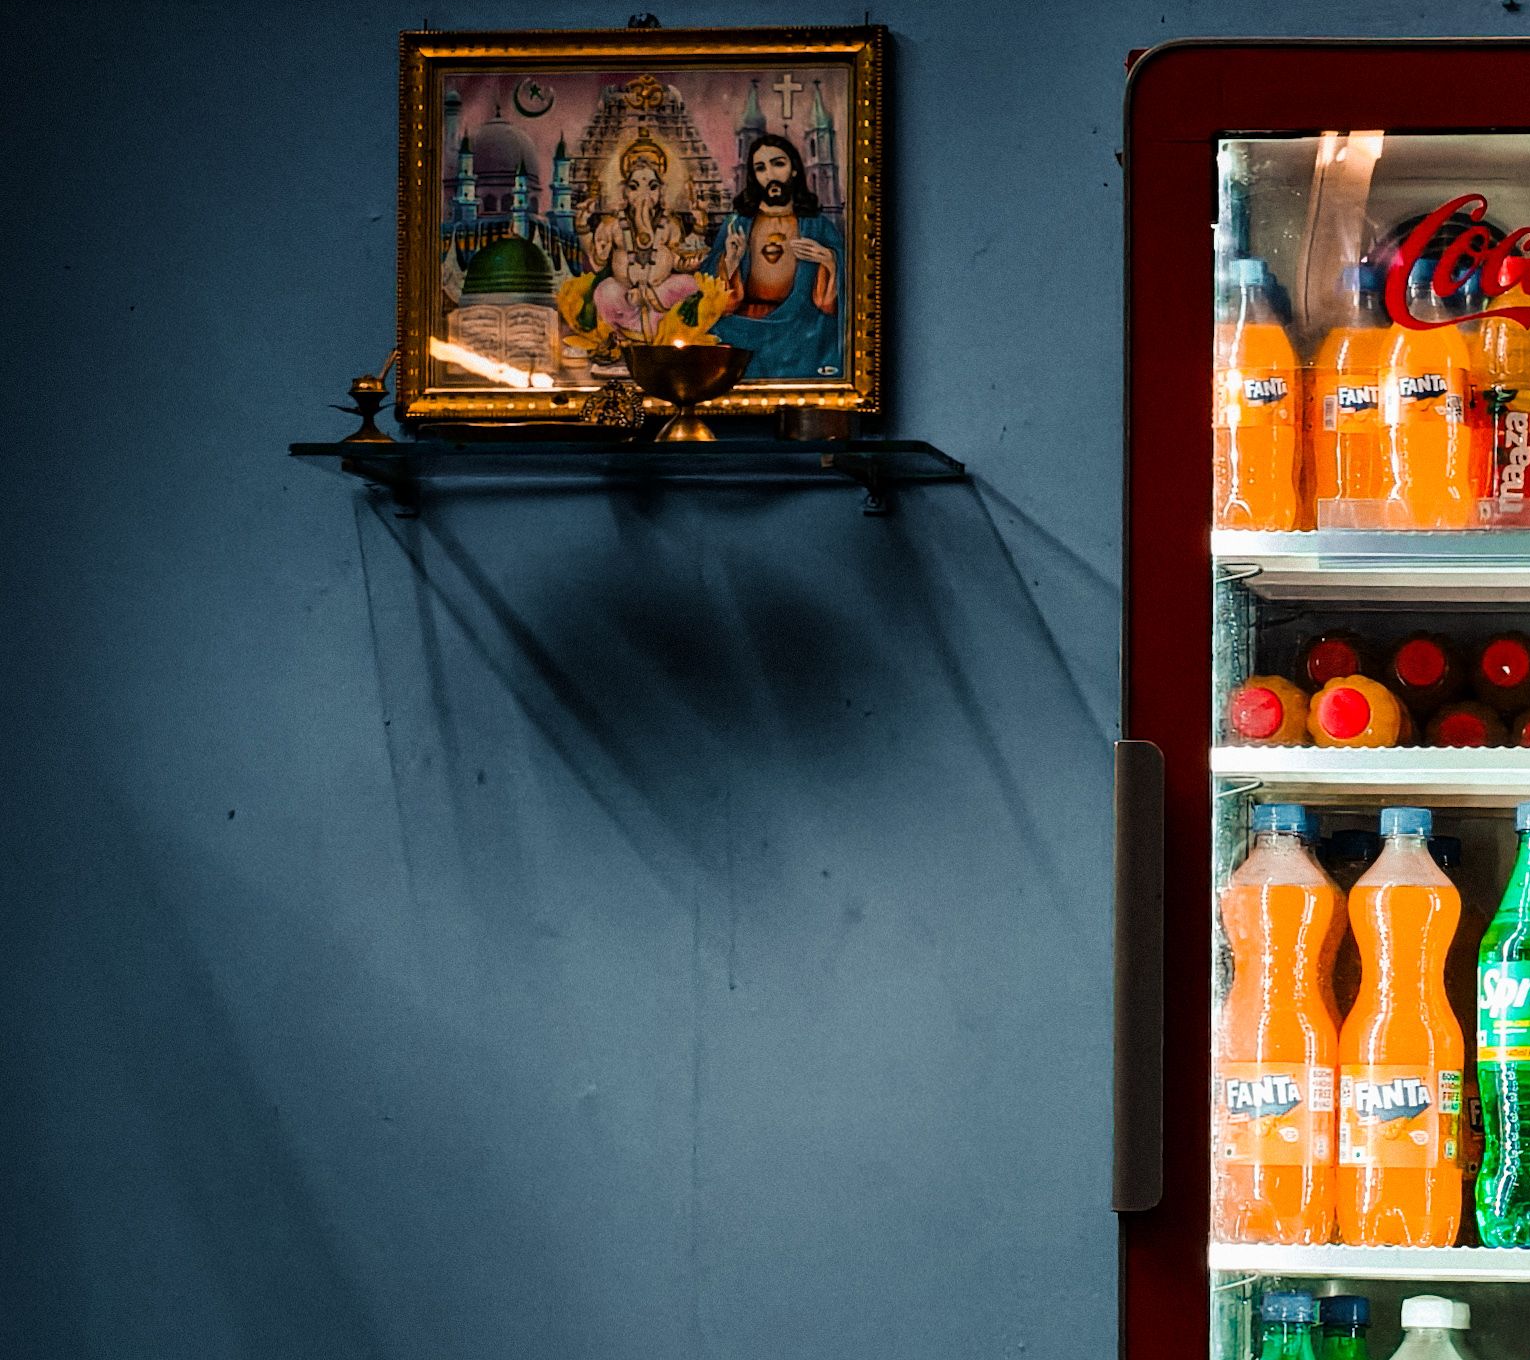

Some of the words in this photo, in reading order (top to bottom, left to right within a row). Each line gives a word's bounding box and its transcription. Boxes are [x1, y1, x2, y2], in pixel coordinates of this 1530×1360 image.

[1338, 386, 1379, 407] FANT
[1400, 374, 1448, 397] FANTA
[1226, 1075, 1302, 1110] FANTA
[1354, 1077, 1431, 1113] FANTA
